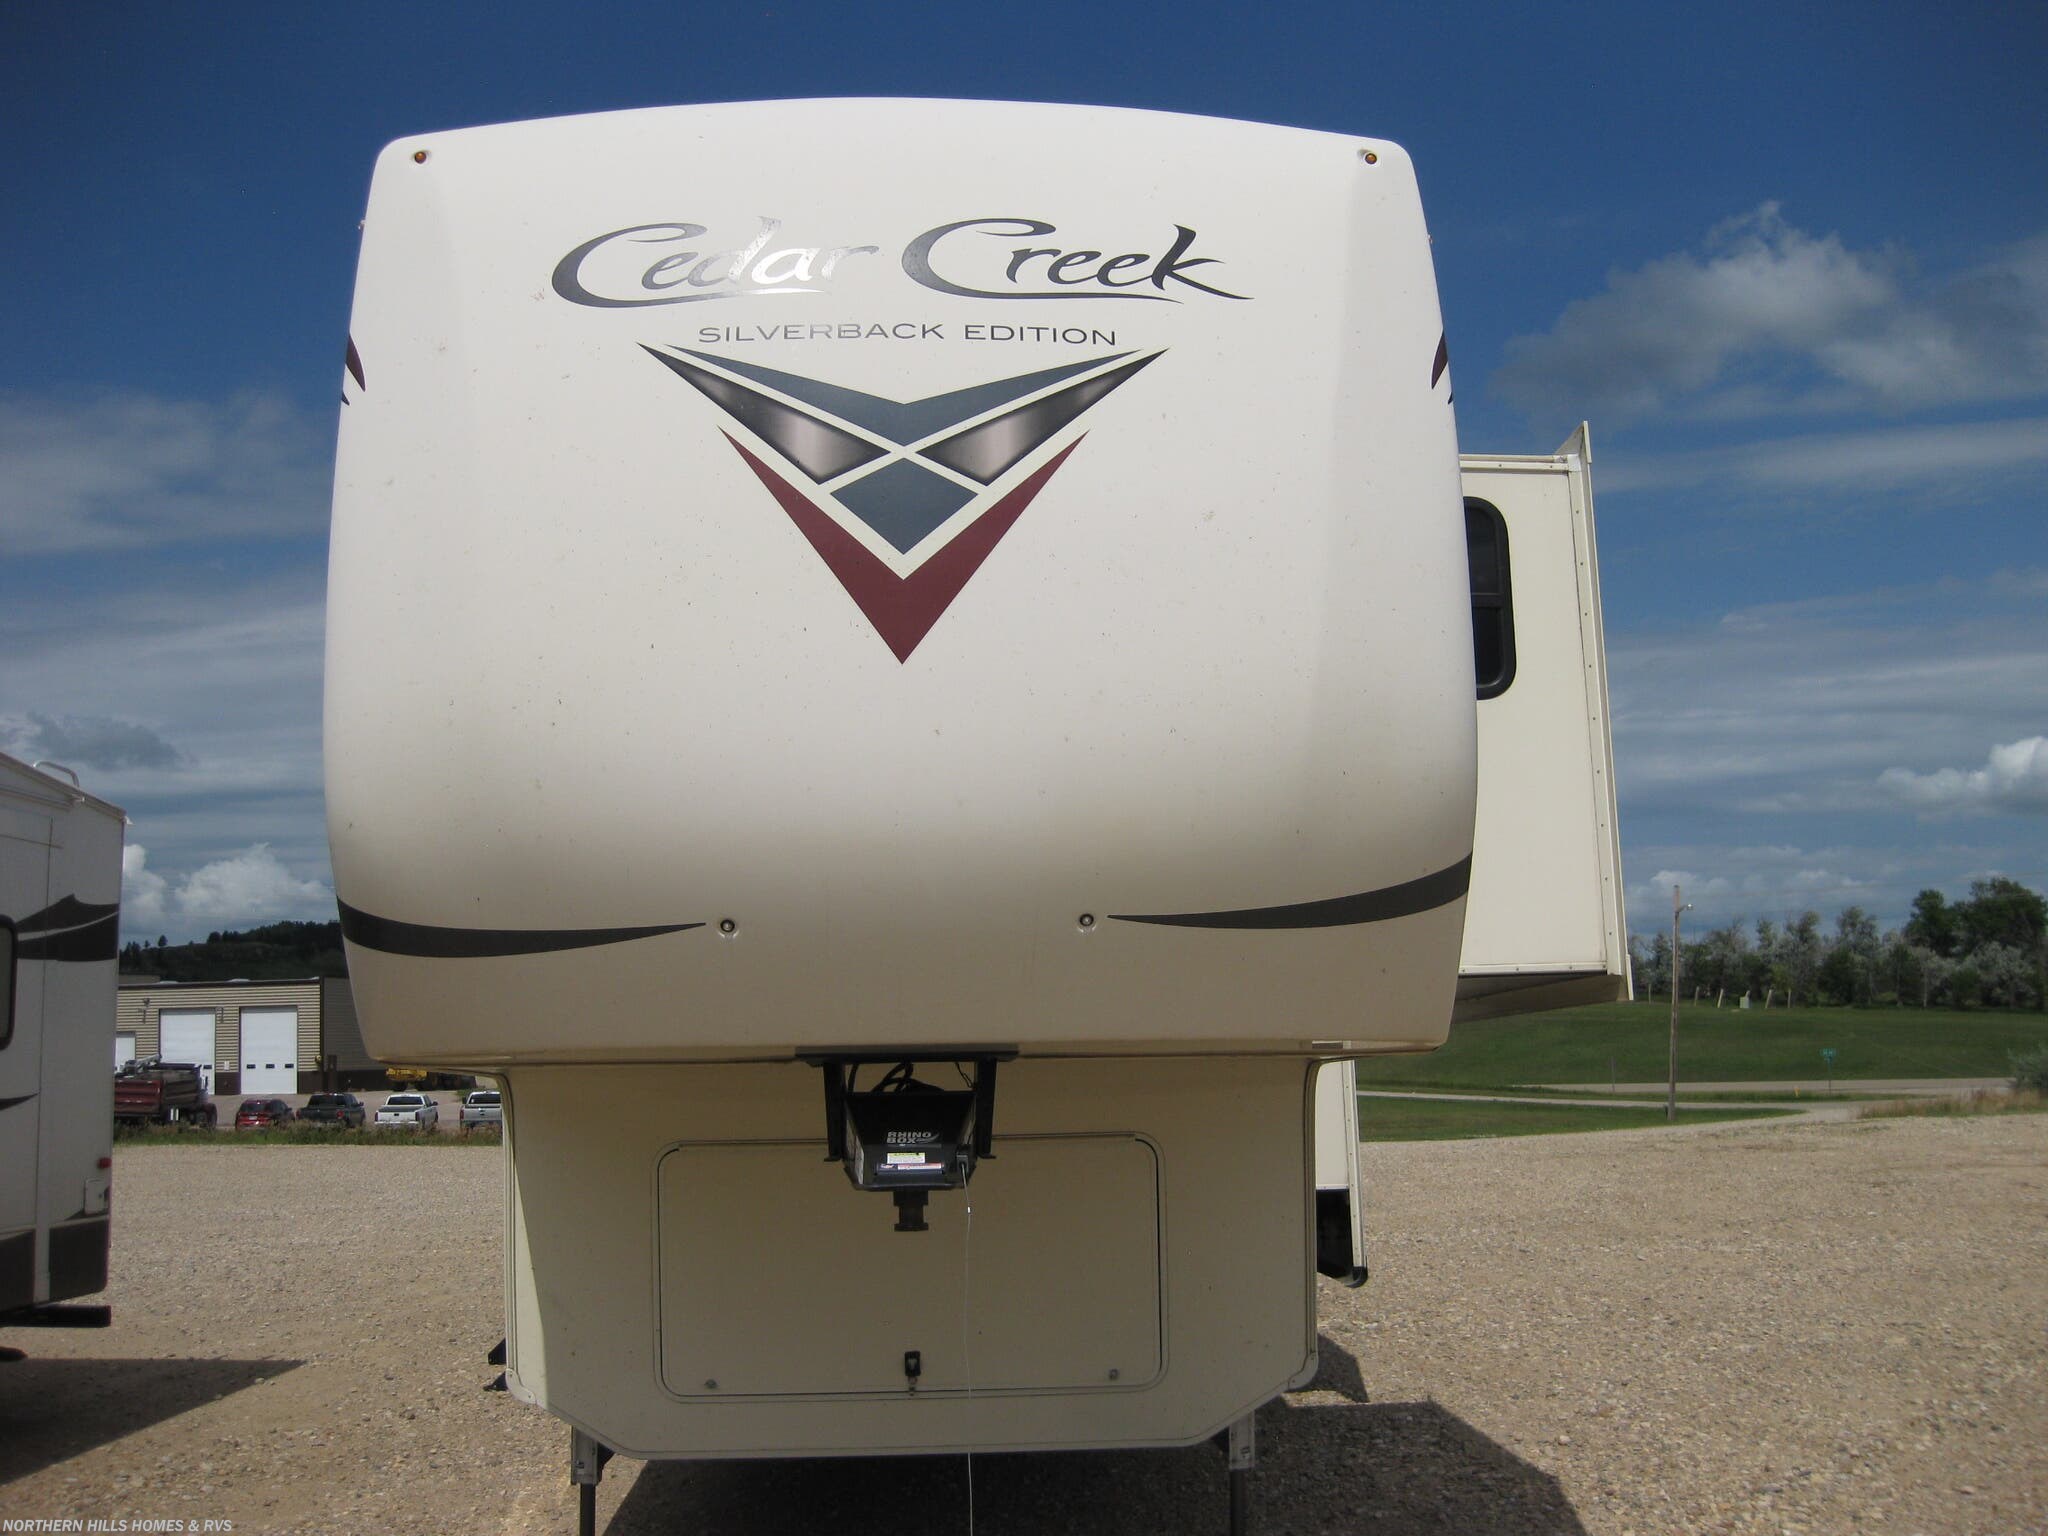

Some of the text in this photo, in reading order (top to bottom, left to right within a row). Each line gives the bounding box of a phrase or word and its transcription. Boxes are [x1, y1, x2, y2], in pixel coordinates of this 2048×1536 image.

[552, 216, 1255, 308] Cedar Creek
[698, 323, 1116, 346] SILVERBACK EDITION
